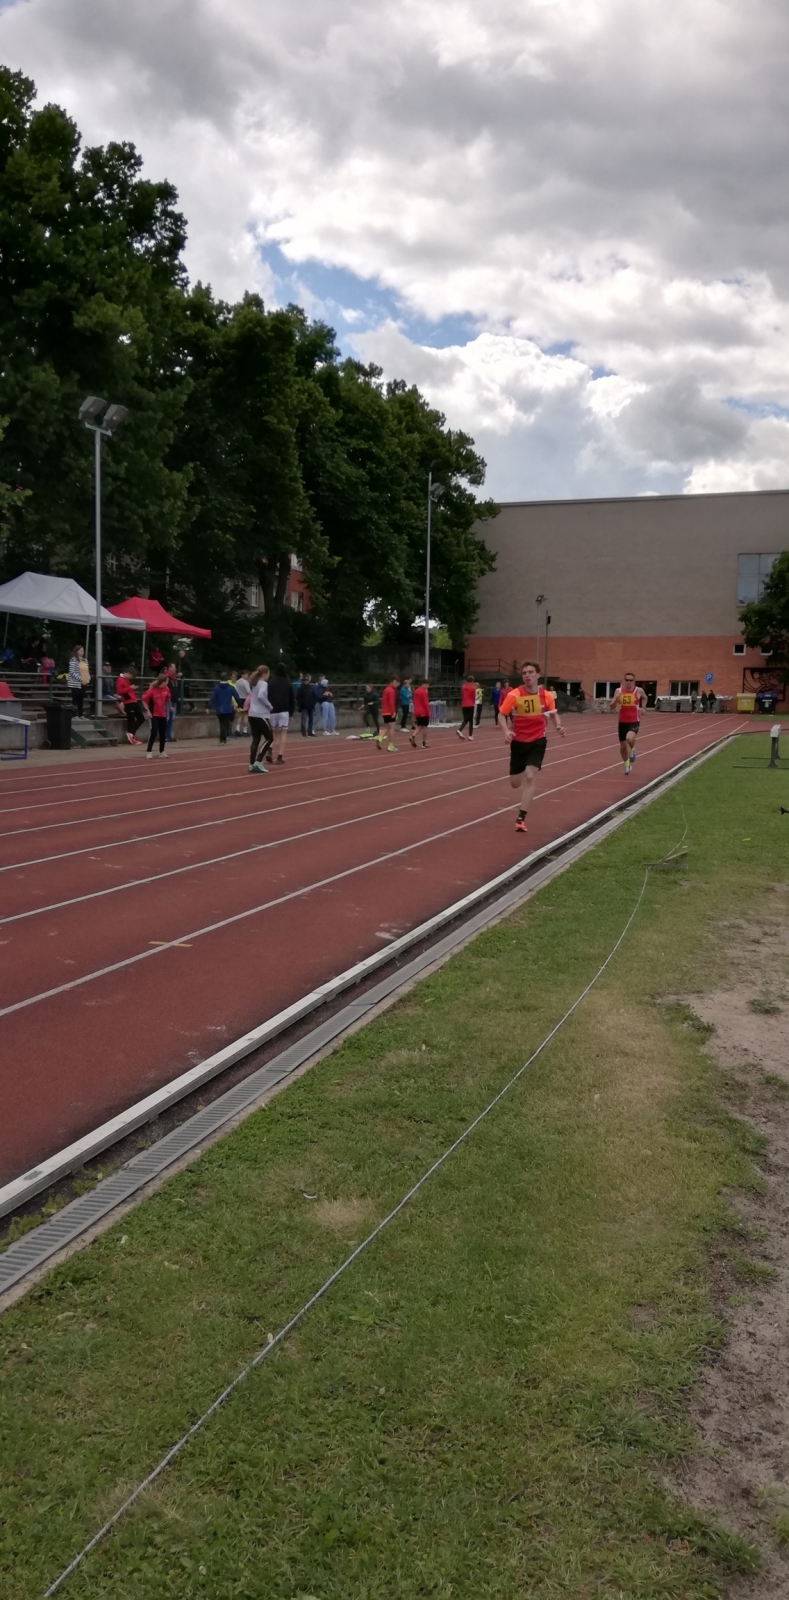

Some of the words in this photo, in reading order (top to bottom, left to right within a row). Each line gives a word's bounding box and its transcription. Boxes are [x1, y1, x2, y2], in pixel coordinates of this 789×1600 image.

[706, 673, 712, 681] P
[622, 695, 631, 704] 63
[524, 699, 535, 713] 31
